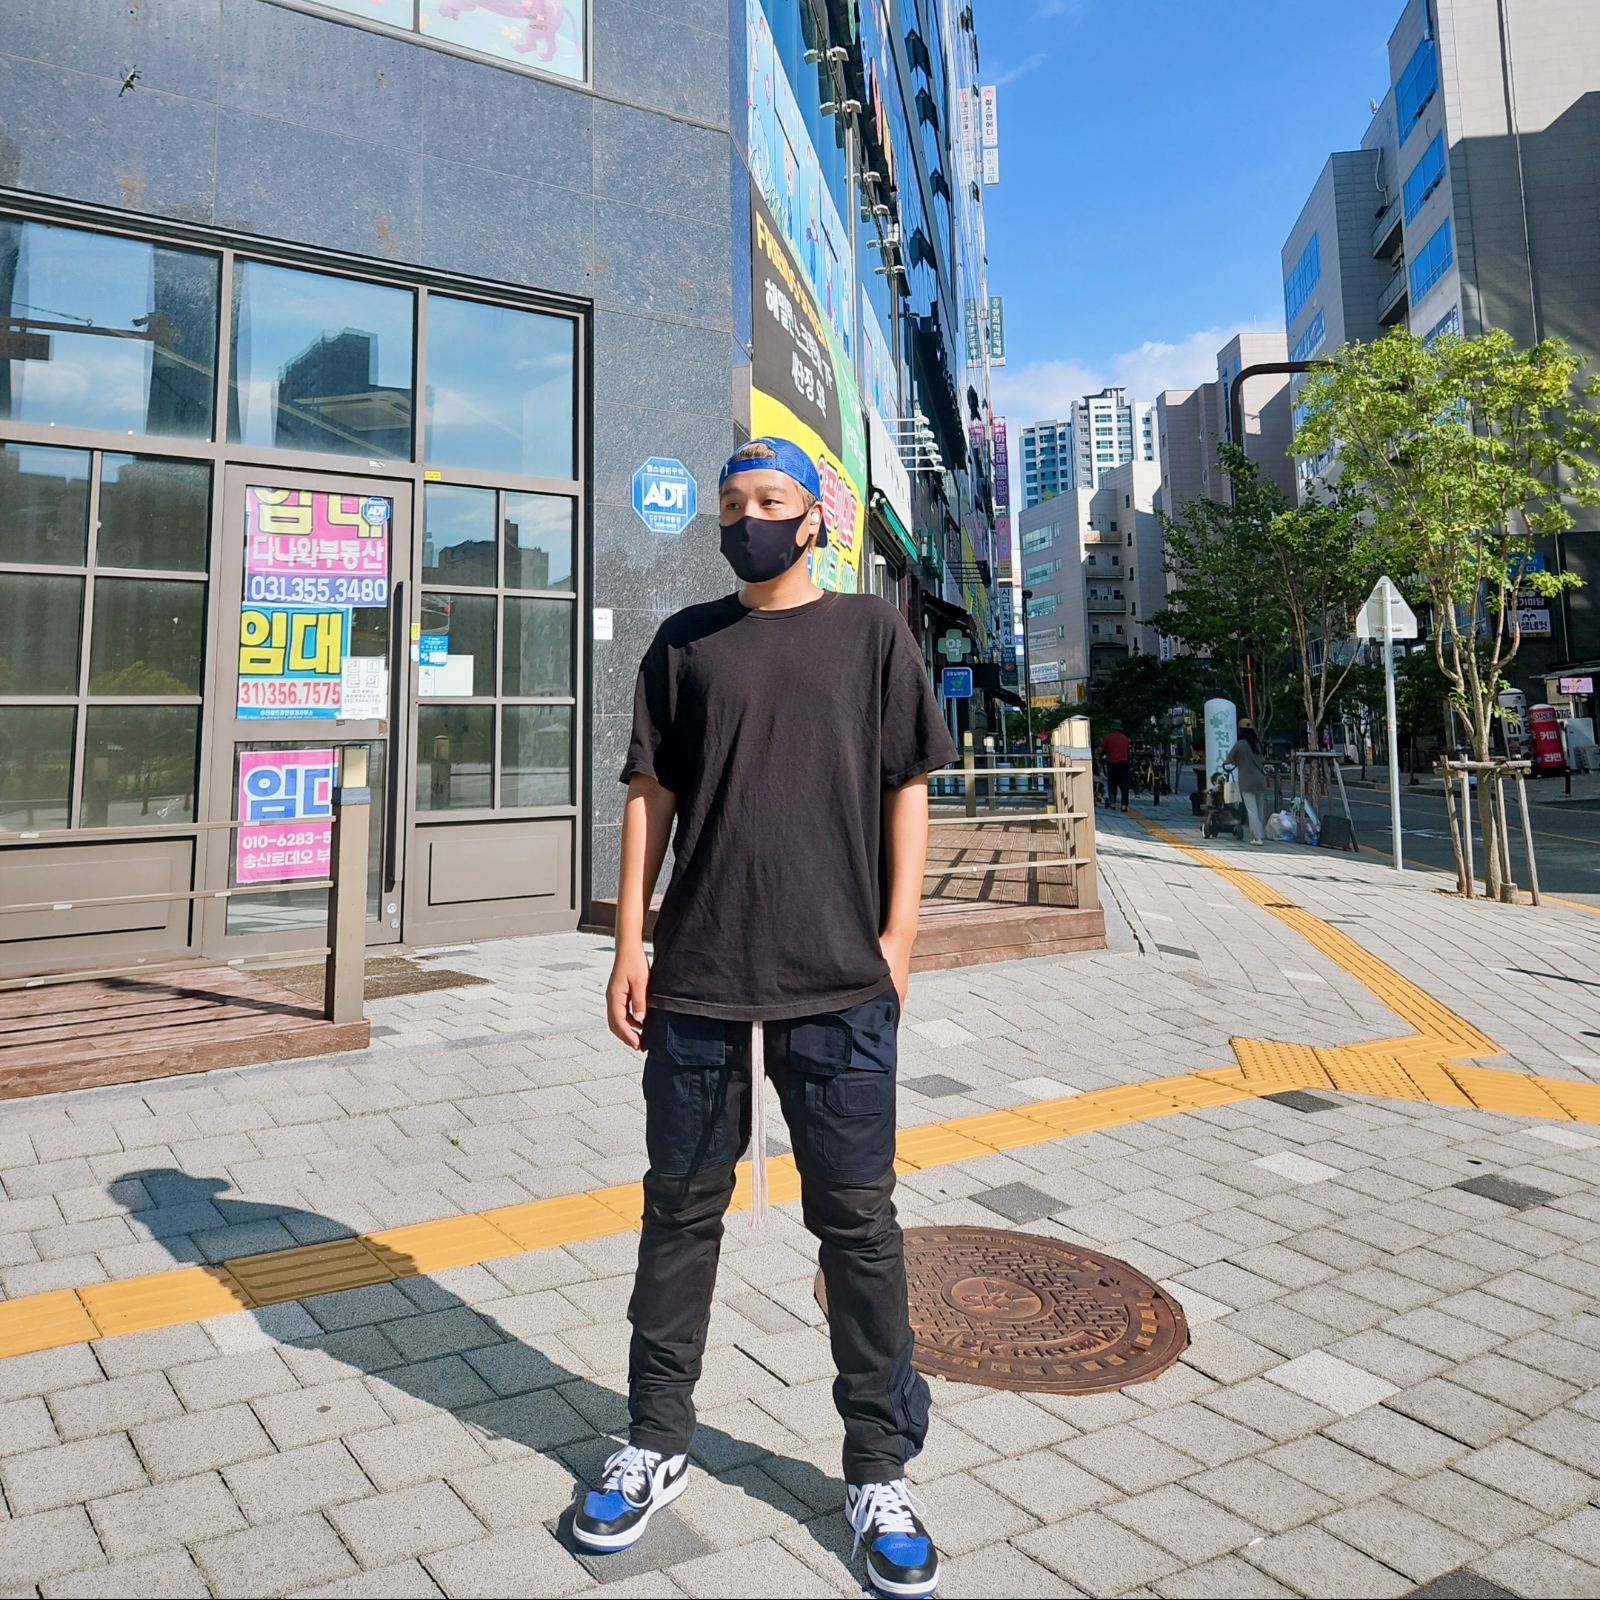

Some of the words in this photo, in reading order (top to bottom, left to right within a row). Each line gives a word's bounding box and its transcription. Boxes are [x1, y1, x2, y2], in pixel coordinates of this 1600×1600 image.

[643, 480, 687, 509] ADT
[367, 505, 386, 518] ADT
[252, 535, 384, 569] 다나와부동산
[250, 577, 388, 603] 031.355.3480
[1511, 620, 1548, 631] 생네컷
[239, 611, 343, 676] 임대
[945, 638, 962, 656] 약
[239, 681, 341, 706] 31)356.7575
[1533, 712, 1554, 720] OPEN
[1540, 730, 1557, 741] 커피
[242, 830, 331, 850] 010-6283-5
[242, 849, 314, 869] 송산로데오
